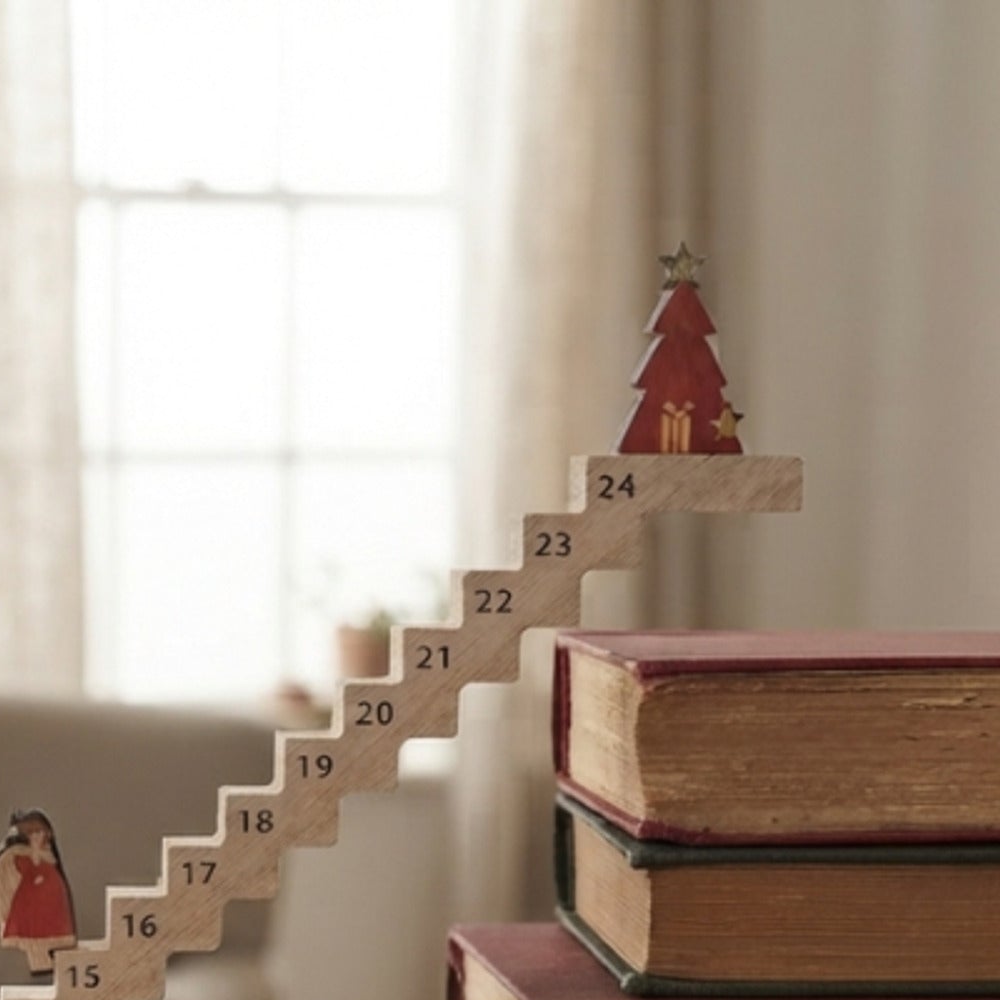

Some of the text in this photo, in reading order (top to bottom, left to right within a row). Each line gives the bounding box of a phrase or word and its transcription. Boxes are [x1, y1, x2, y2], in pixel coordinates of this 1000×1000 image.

[598, 473, 635, 500] 24
[534, 531, 572, 557] 23
[474, 588, 512, 614] 22
[416, 645, 449, 670] 21
[355, 700, 394, 726] 20
[299, 754, 334, 779] 19
[241, 810, 274, 834] 18
[182, 861, 217, 885] 17
[122, 913, 158, 939] 16
[68, 964, 101, 989] 15
